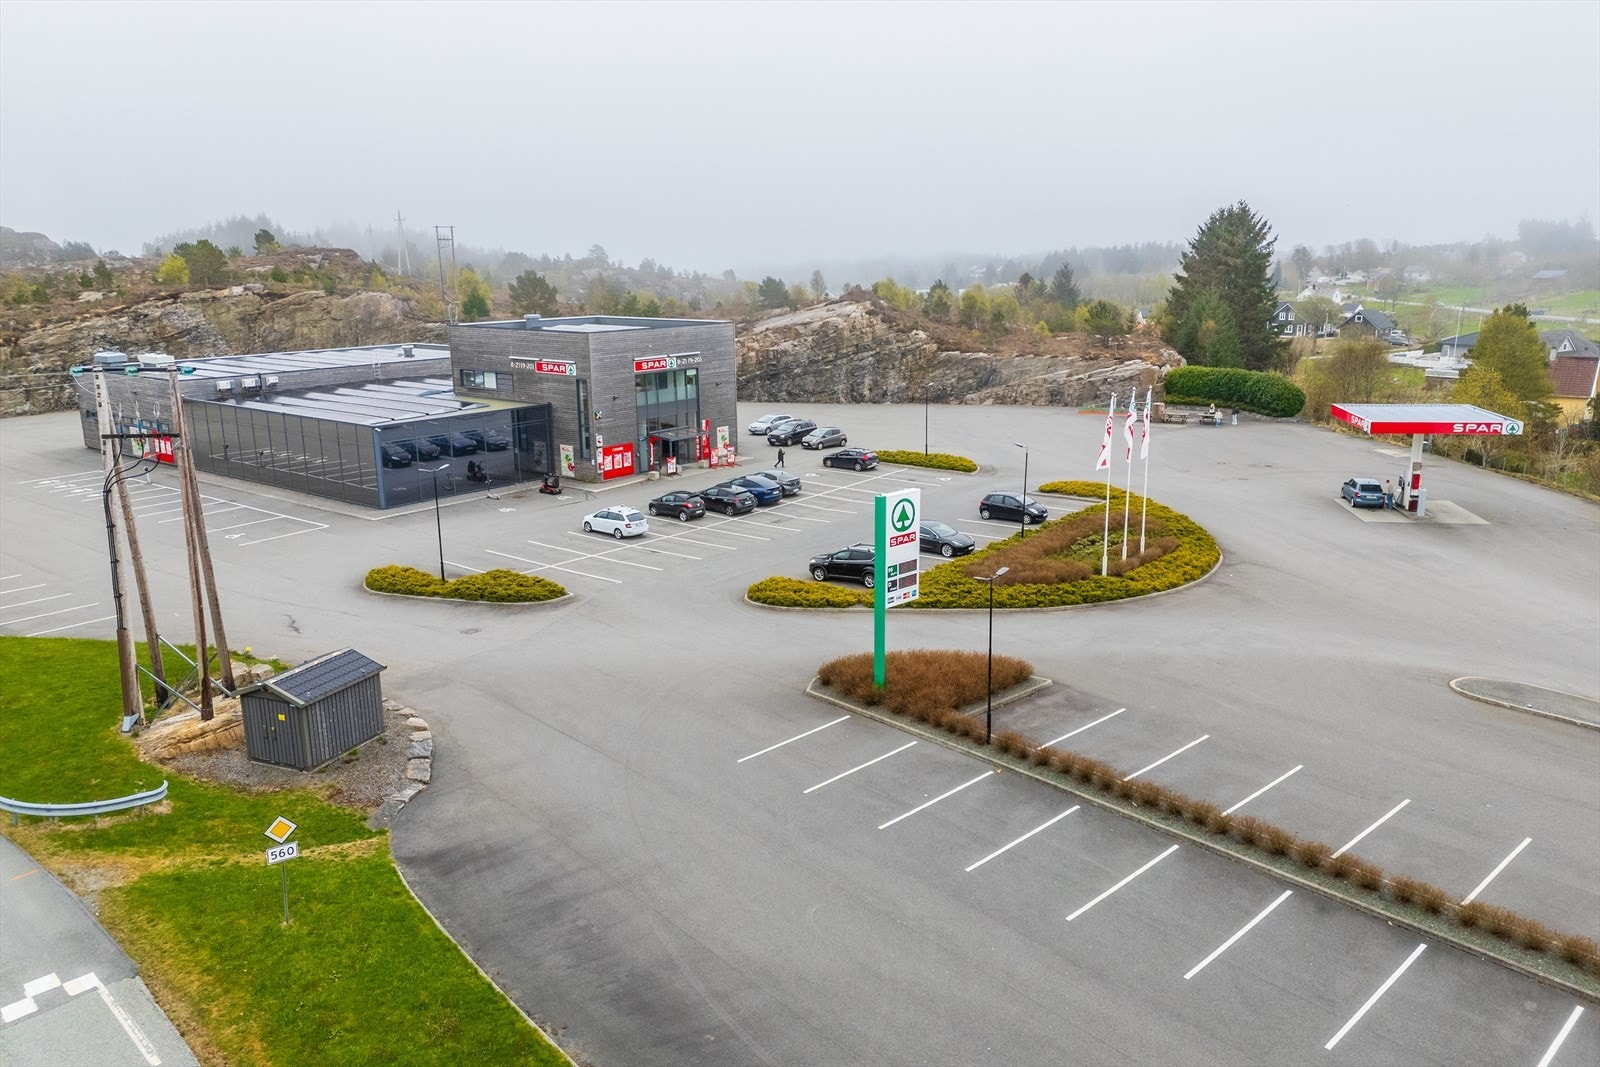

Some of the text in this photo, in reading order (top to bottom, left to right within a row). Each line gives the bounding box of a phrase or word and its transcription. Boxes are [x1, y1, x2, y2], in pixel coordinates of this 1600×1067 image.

[542, 364, 566, 372] SPAR
[642, 360, 666, 370] SPAR
[1351, 415, 1364, 428] SPAR
[1452, 424, 1502, 432] SPAR
[890, 534, 916, 546] SPAR
[270, 846, 294, 860] 560
